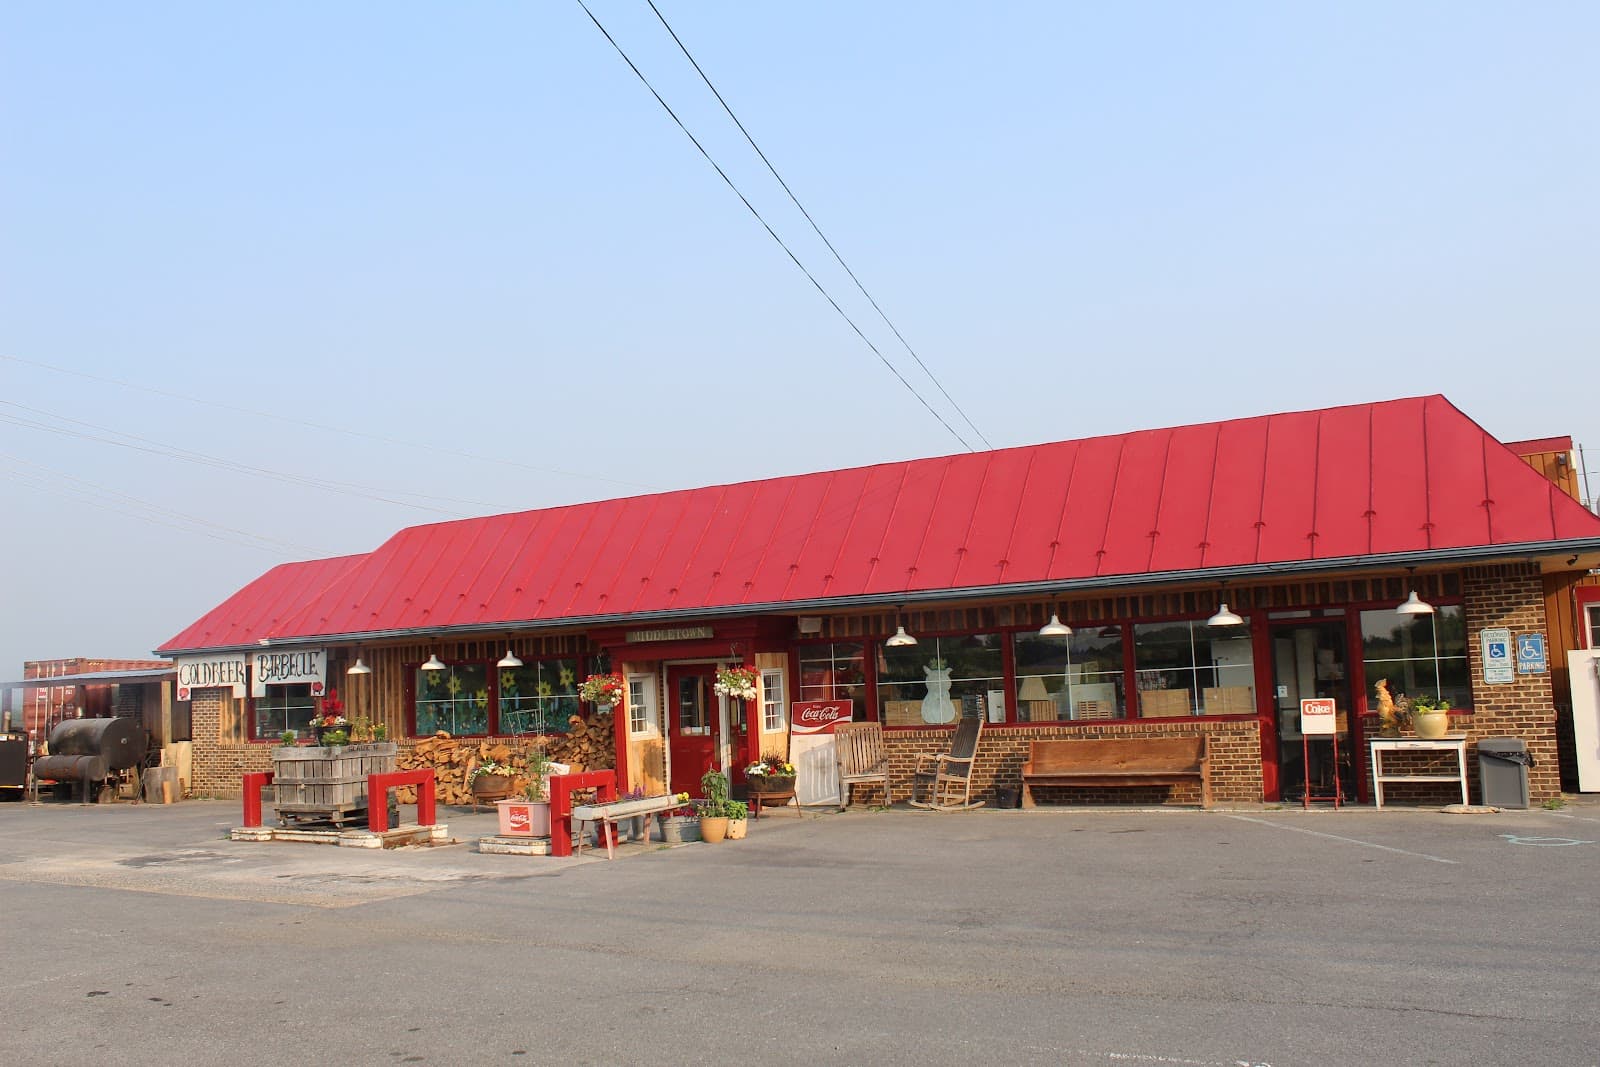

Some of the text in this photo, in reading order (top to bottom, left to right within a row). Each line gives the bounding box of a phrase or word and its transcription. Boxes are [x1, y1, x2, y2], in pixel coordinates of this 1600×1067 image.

[631, 626, 705, 642] MIDDLETOWN
[258, 652, 320, 683] BARBECUE
[1519, 661, 1545, 671] PARKING
[1305, 703, 1331, 714] Coke
